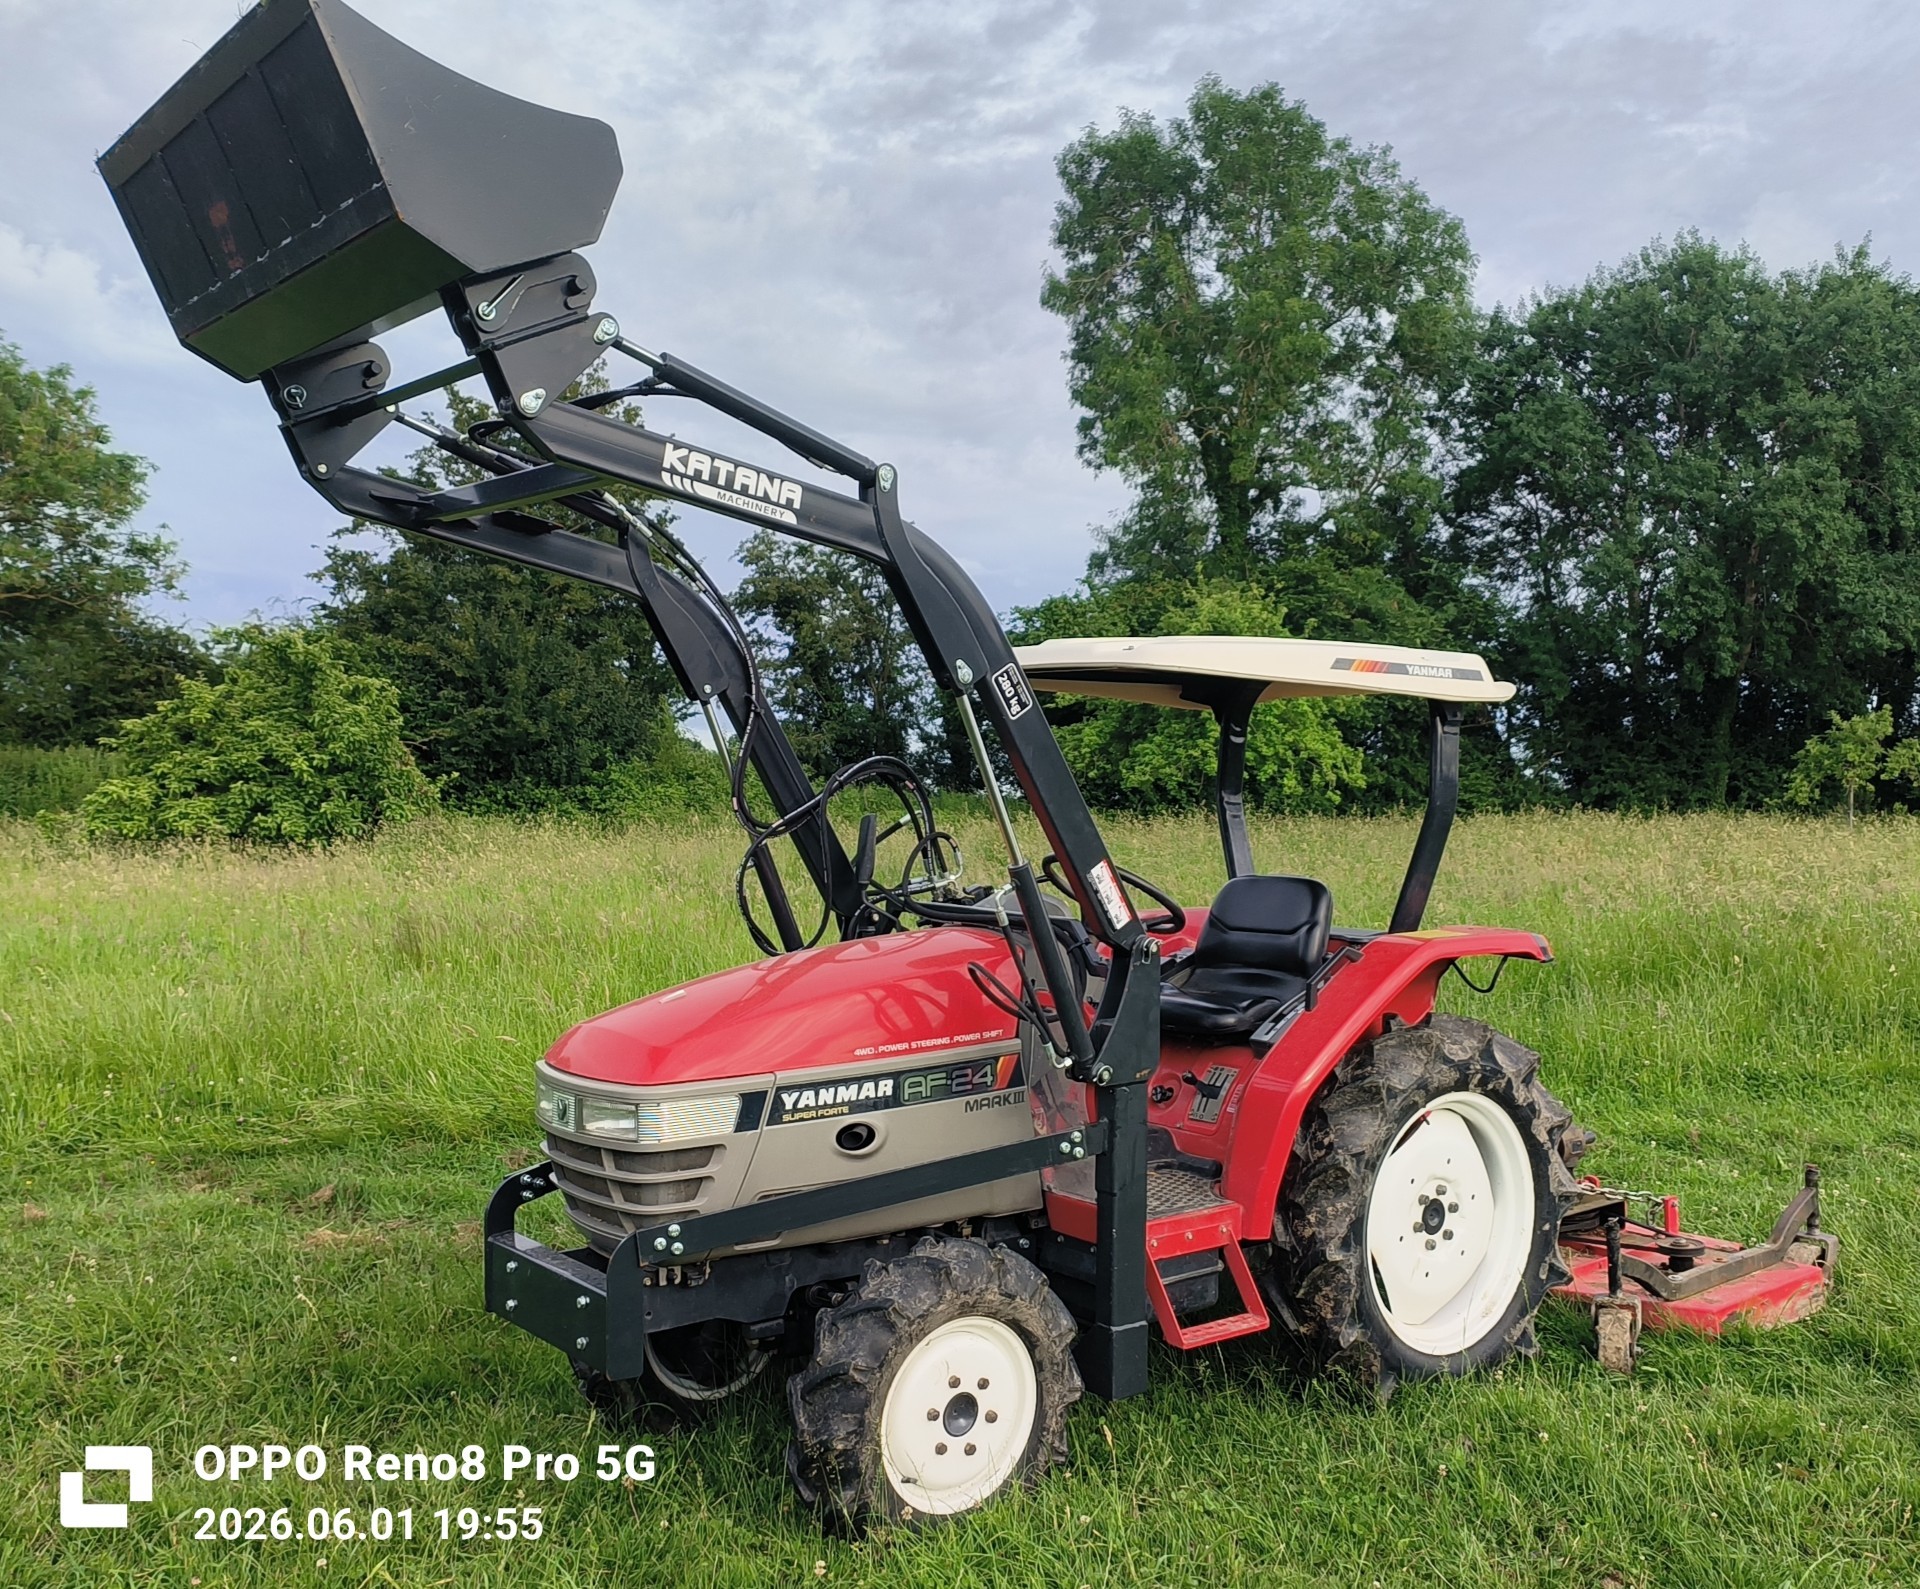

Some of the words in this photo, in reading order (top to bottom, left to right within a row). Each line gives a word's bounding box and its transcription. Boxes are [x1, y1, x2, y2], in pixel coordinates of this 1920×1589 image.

[662, 442, 803, 510] KATANA
[716, 491, 786, 519] MACHINERY
[1405, 664, 1453, 678] YANMAR
[998, 672, 1015, 698] 280
[1009, 696, 1021, 715] kg
[878, 1042, 909, 1053] POWER
[982, 1029, 1003, 1039] SHIFT
[781, 1079, 894, 1110] YANMAR
[904, 1064, 994, 1101] AF-24
[782, 1109, 817, 1122] SUPER
[817, 1105, 849, 1117] FORTE
